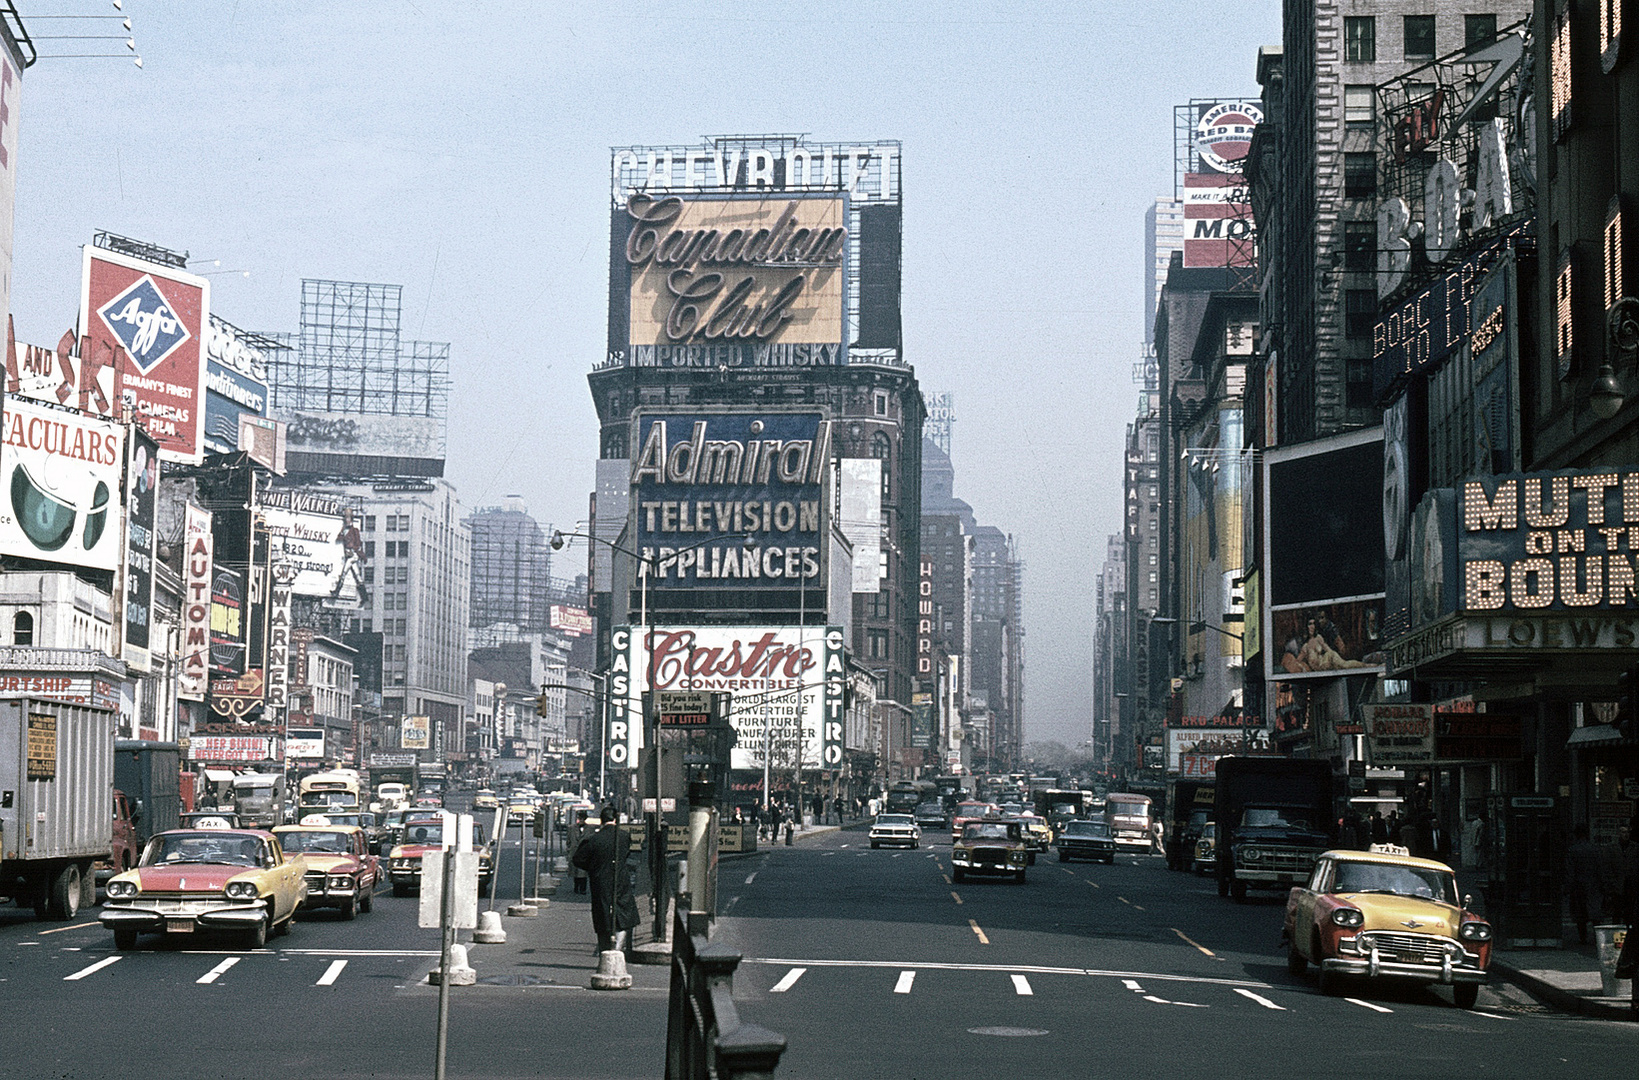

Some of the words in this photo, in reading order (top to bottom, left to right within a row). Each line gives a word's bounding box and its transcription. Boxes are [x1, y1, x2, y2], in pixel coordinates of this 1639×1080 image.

[1194, 126, 1228, 139] RED
[626, 193, 849, 264] Canadian
[666, 268, 808, 341] Club
[110, 297, 177, 356] Agfa
[23, 344, 52, 377] AND
[630, 343, 743, 367] IMPORTED
[753, 342, 840, 367] WHISKY
[630, 420, 832, 485] Admiral
[641, 501, 820, 532] TELEVISION
[293, 522, 332, 543] WHISKY
[1525, 529, 1586, 554] ON
[637, 546, 820, 579] APPLIANCES
[919, 562, 932, 673] HOWARD
[269, 589, 290, 705] WARNER
[643, 630, 816, 691] Castro
[678, 678, 806, 690] CONVERTIBLES
[610, 631, 630, 764] CASTRO
[688, 693, 702, 702] risk
[770, 694, 816, 704] LARGST
[824, 631, 843, 764] CASTRO
[678, 714, 708, 724] LITTER
[1181, 715, 1208, 726] RKO
[1212, 715, 1261, 726] PALACE
[194, 749, 225, 760] NEVER
[225, 749, 244, 760] GOT
[246, 750, 267, 761] WET
[206, 737, 227, 749] HER
[229, 737, 264, 750] BIKINI
[200, 820, 222, 828] TAXI
[1379, 846, 1401, 854] TAXI
